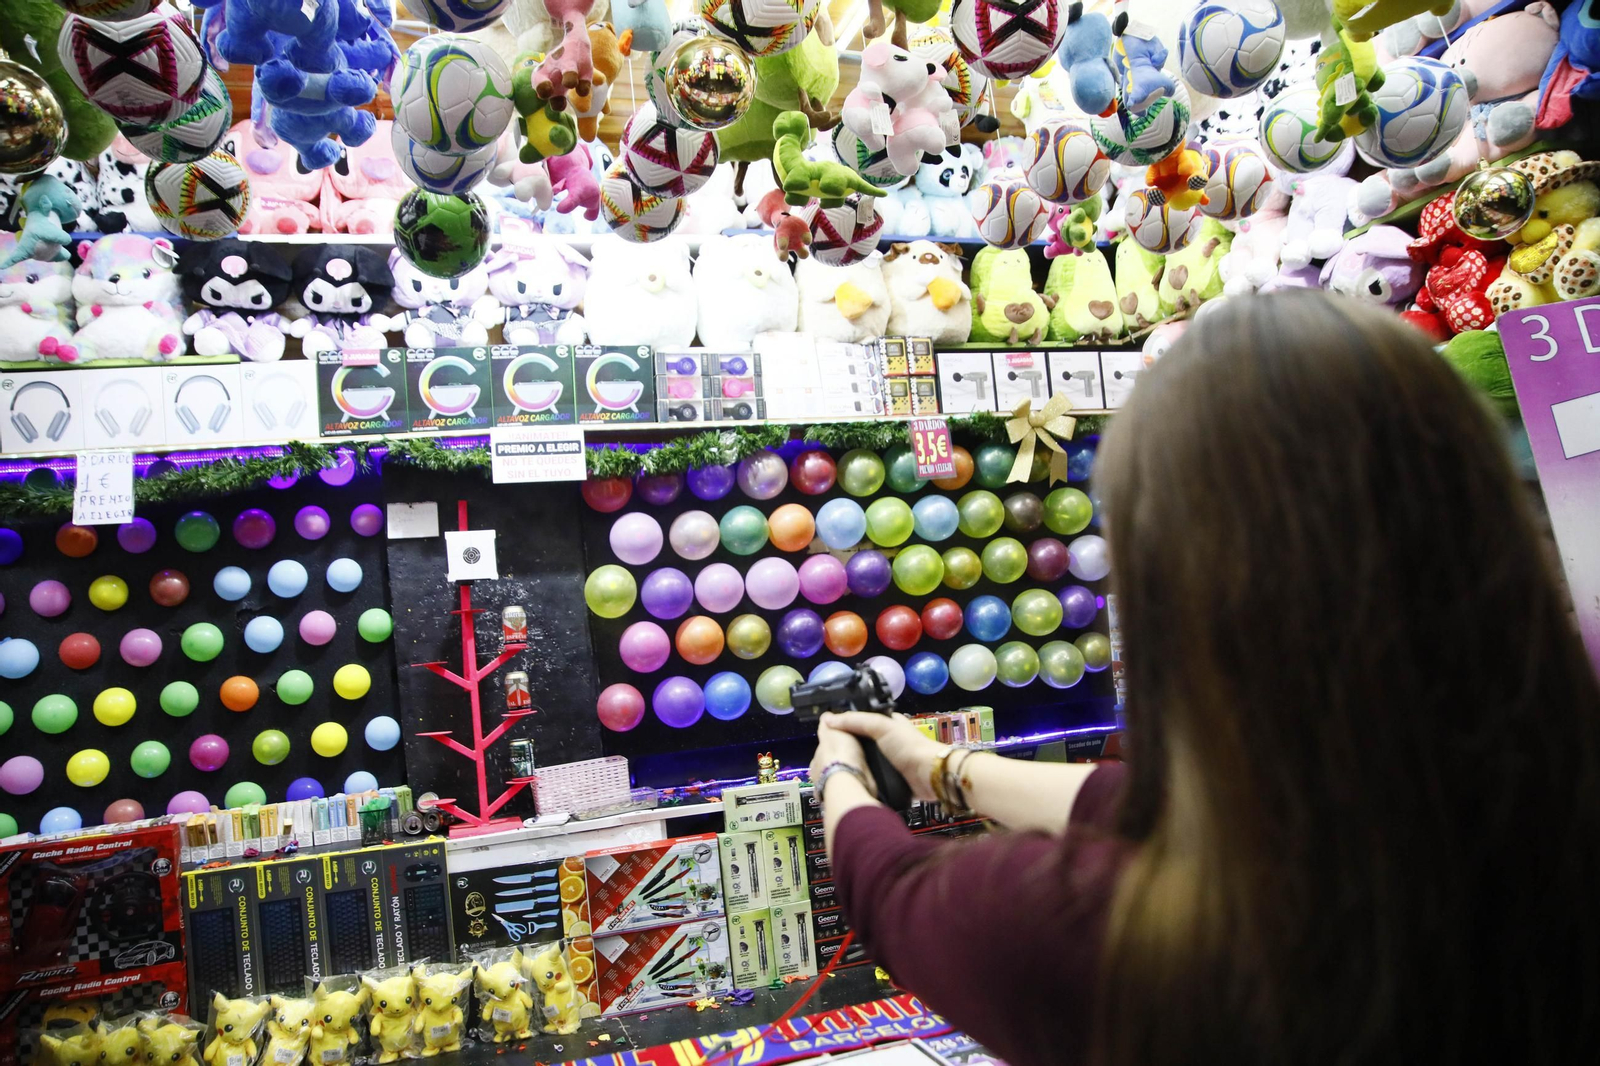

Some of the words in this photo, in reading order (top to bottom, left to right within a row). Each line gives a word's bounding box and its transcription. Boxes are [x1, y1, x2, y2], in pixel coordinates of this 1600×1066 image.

[1521, 314, 1559, 361] 3
[413, 419, 446, 427] ALTAVOZ
[446, 417, 487, 426] CARGADOR
[497, 415, 530, 423] ALTAVOZ
[530, 413, 570, 422] CARGADOR
[580, 412, 610, 420] ALTAVOZ
[325, 422, 359, 430] ALTAVOZ
[360, 420, 403, 430] CARGADOR
[498, 445, 535, 454] PREMIO
[537, 444, 545, 453] A
[546, 442, 579, 453] ELEGIR
[916, 432, 948, 465] 3,5€
[502, 458, 517, 467] NO
[520, 458, 533, 466] TE
[537, 456, 577, 465] QUEDES
[508, 470, 525, 479] SIN
[529, 470, 540, 478] EL
[99, 473, 110, 489] €
[80, 495, 131, 508] PREMIO
[1068, 741, 1086, 749] Secador
[32, 849, 63, 860] Coche
[66, 845, 94, 855] Radio
[96, 840, 132, 850] Control
[814, 886, 836, 895] Geemy
[371, 877, 382, 919] CONJUNTO
[306, 886, 316, 929] CONJUNTO
[391, 896, 401, 923] RATÓN
[239, 896, 249, 939] CONJUNTO
[818, 914, 839, 923] Geemy
[375, 920, 383, 931] DE
[309, 930, 318, 942] DE
[242, 940, 250, 952] DE
[376, 933, 386, 969] TECLADO
[395, 931, 405, 966] TECLADO
[820, 945, 842, 953] Geemy
[310, 943, 321, 979] TECLADO
[243, 953, 253, 990] TECLADO
[40, 987, 71, 997] Coche
[74, 980, 102, 992] Radio
[104, 974, 142, 986] Control
